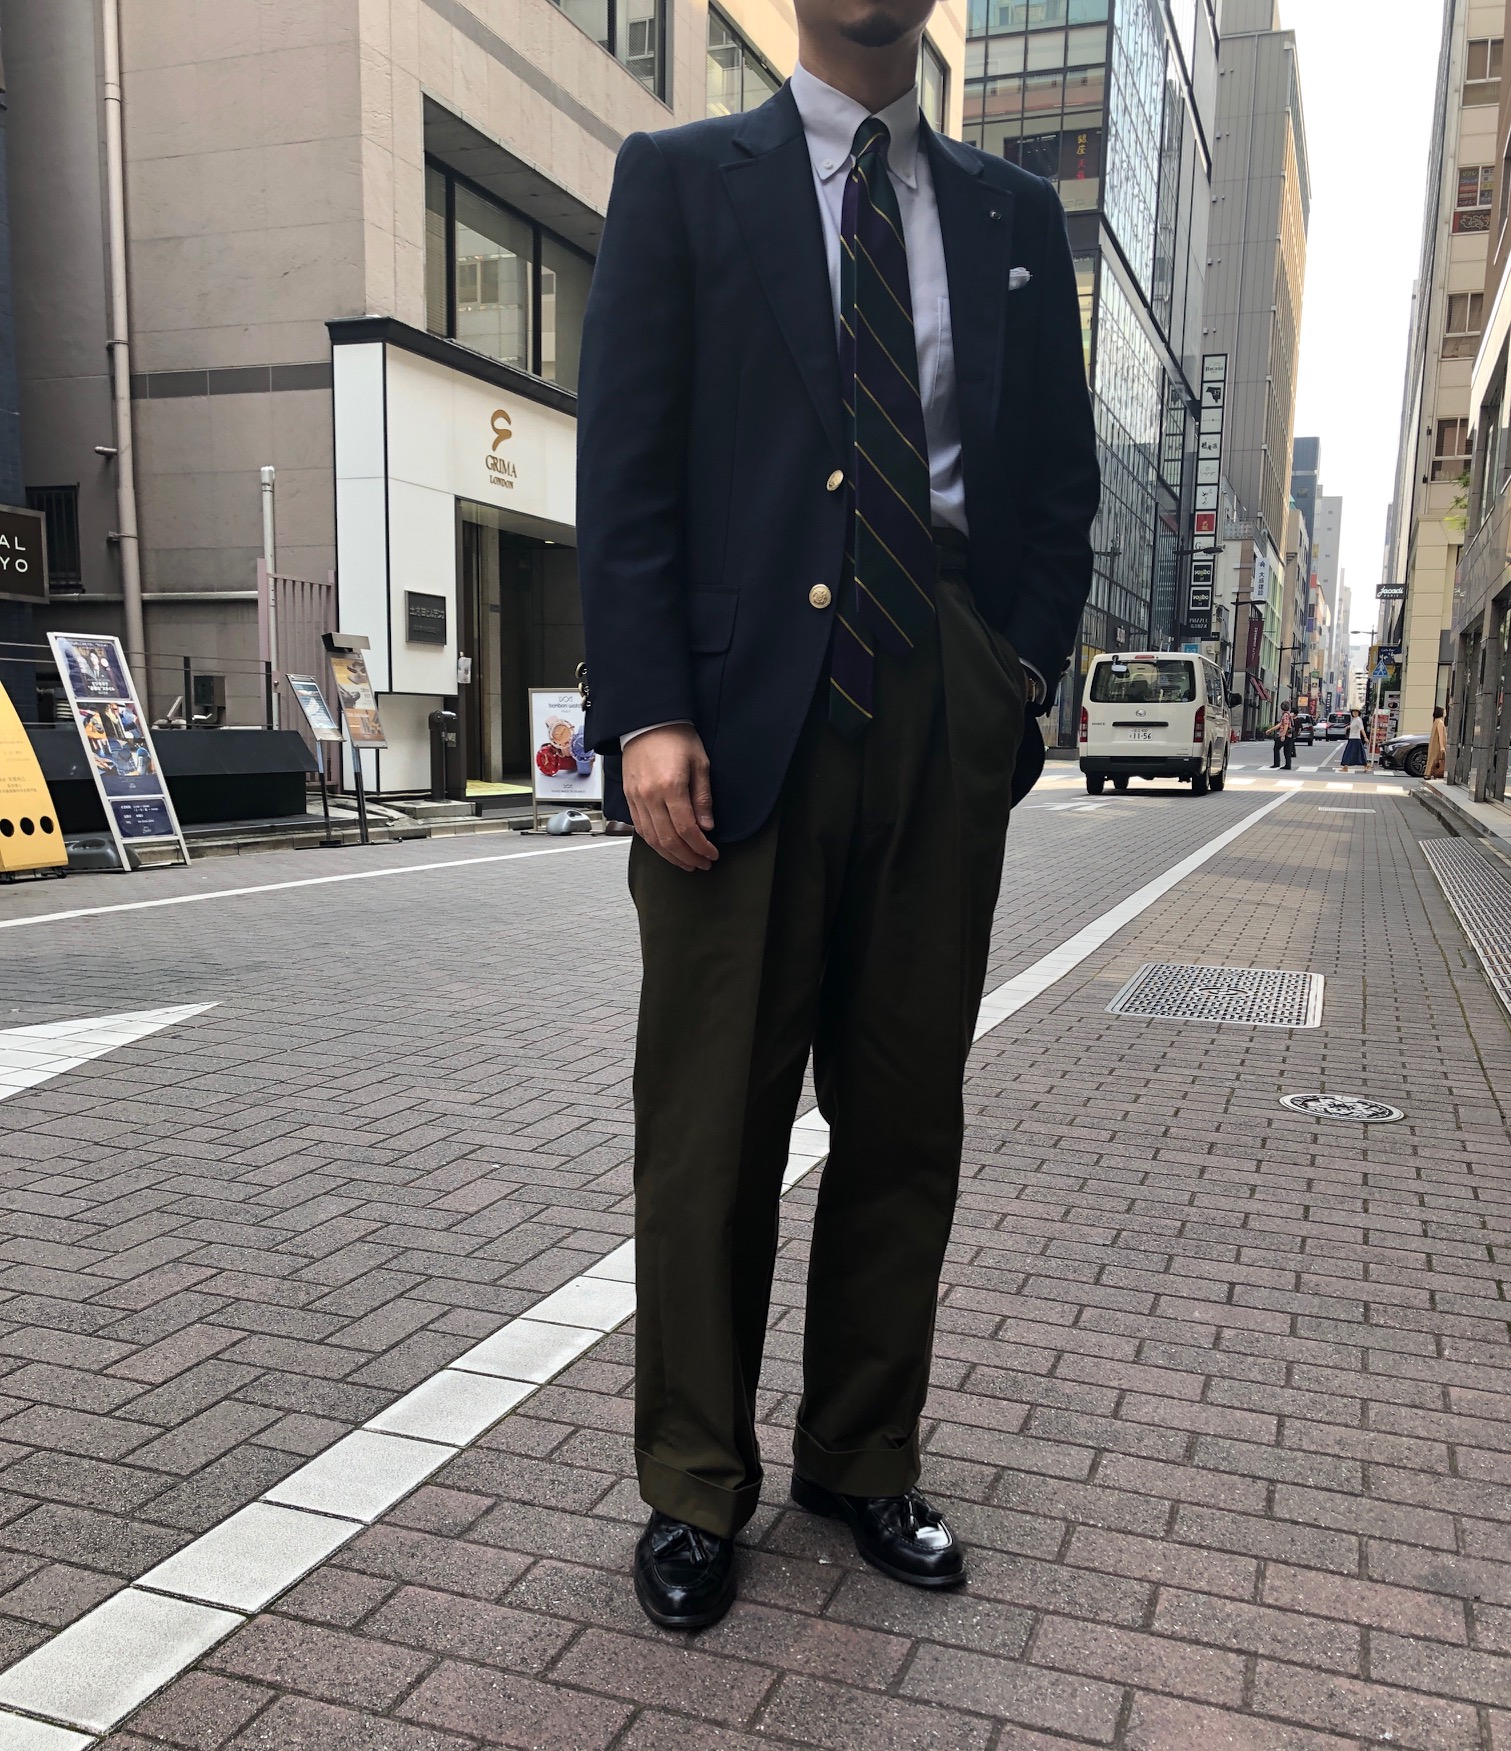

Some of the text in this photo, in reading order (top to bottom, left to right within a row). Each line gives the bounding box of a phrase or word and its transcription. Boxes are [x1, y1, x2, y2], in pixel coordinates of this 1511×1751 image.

[485, 454, 518, 478] GRIMA
[489, 474, 514, 489] LONDON
[1376, 585, 1404, 598] jacadi
[1133, 732, 1152, 740] 11-56
